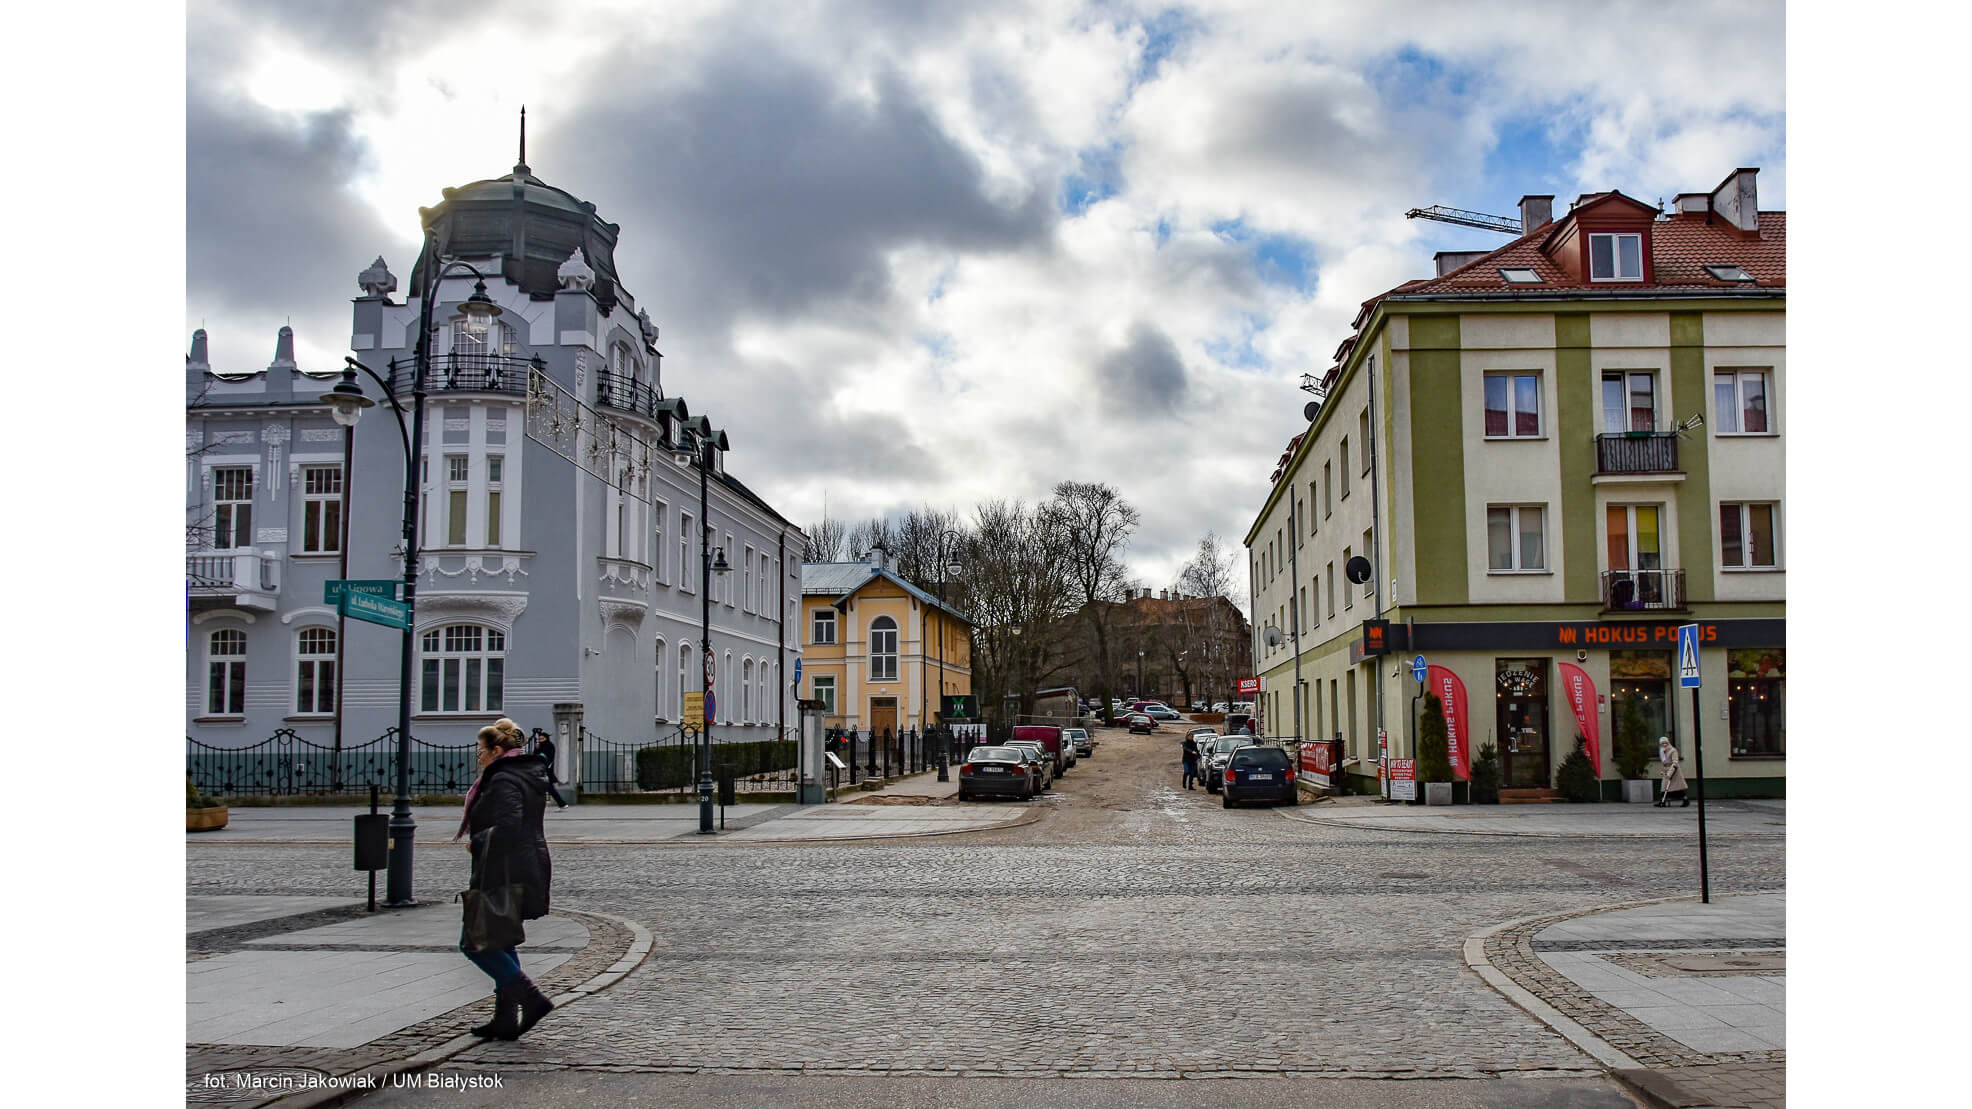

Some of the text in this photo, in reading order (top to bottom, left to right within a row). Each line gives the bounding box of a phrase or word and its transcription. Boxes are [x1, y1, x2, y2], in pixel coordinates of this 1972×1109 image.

[347, 583, 383, 593] Lipowa
[1585, 626, 1647, 643] HOKUS
[1655, 625, 1717, 642] POUS
[1241, 680, 1257, 688] KSERO
